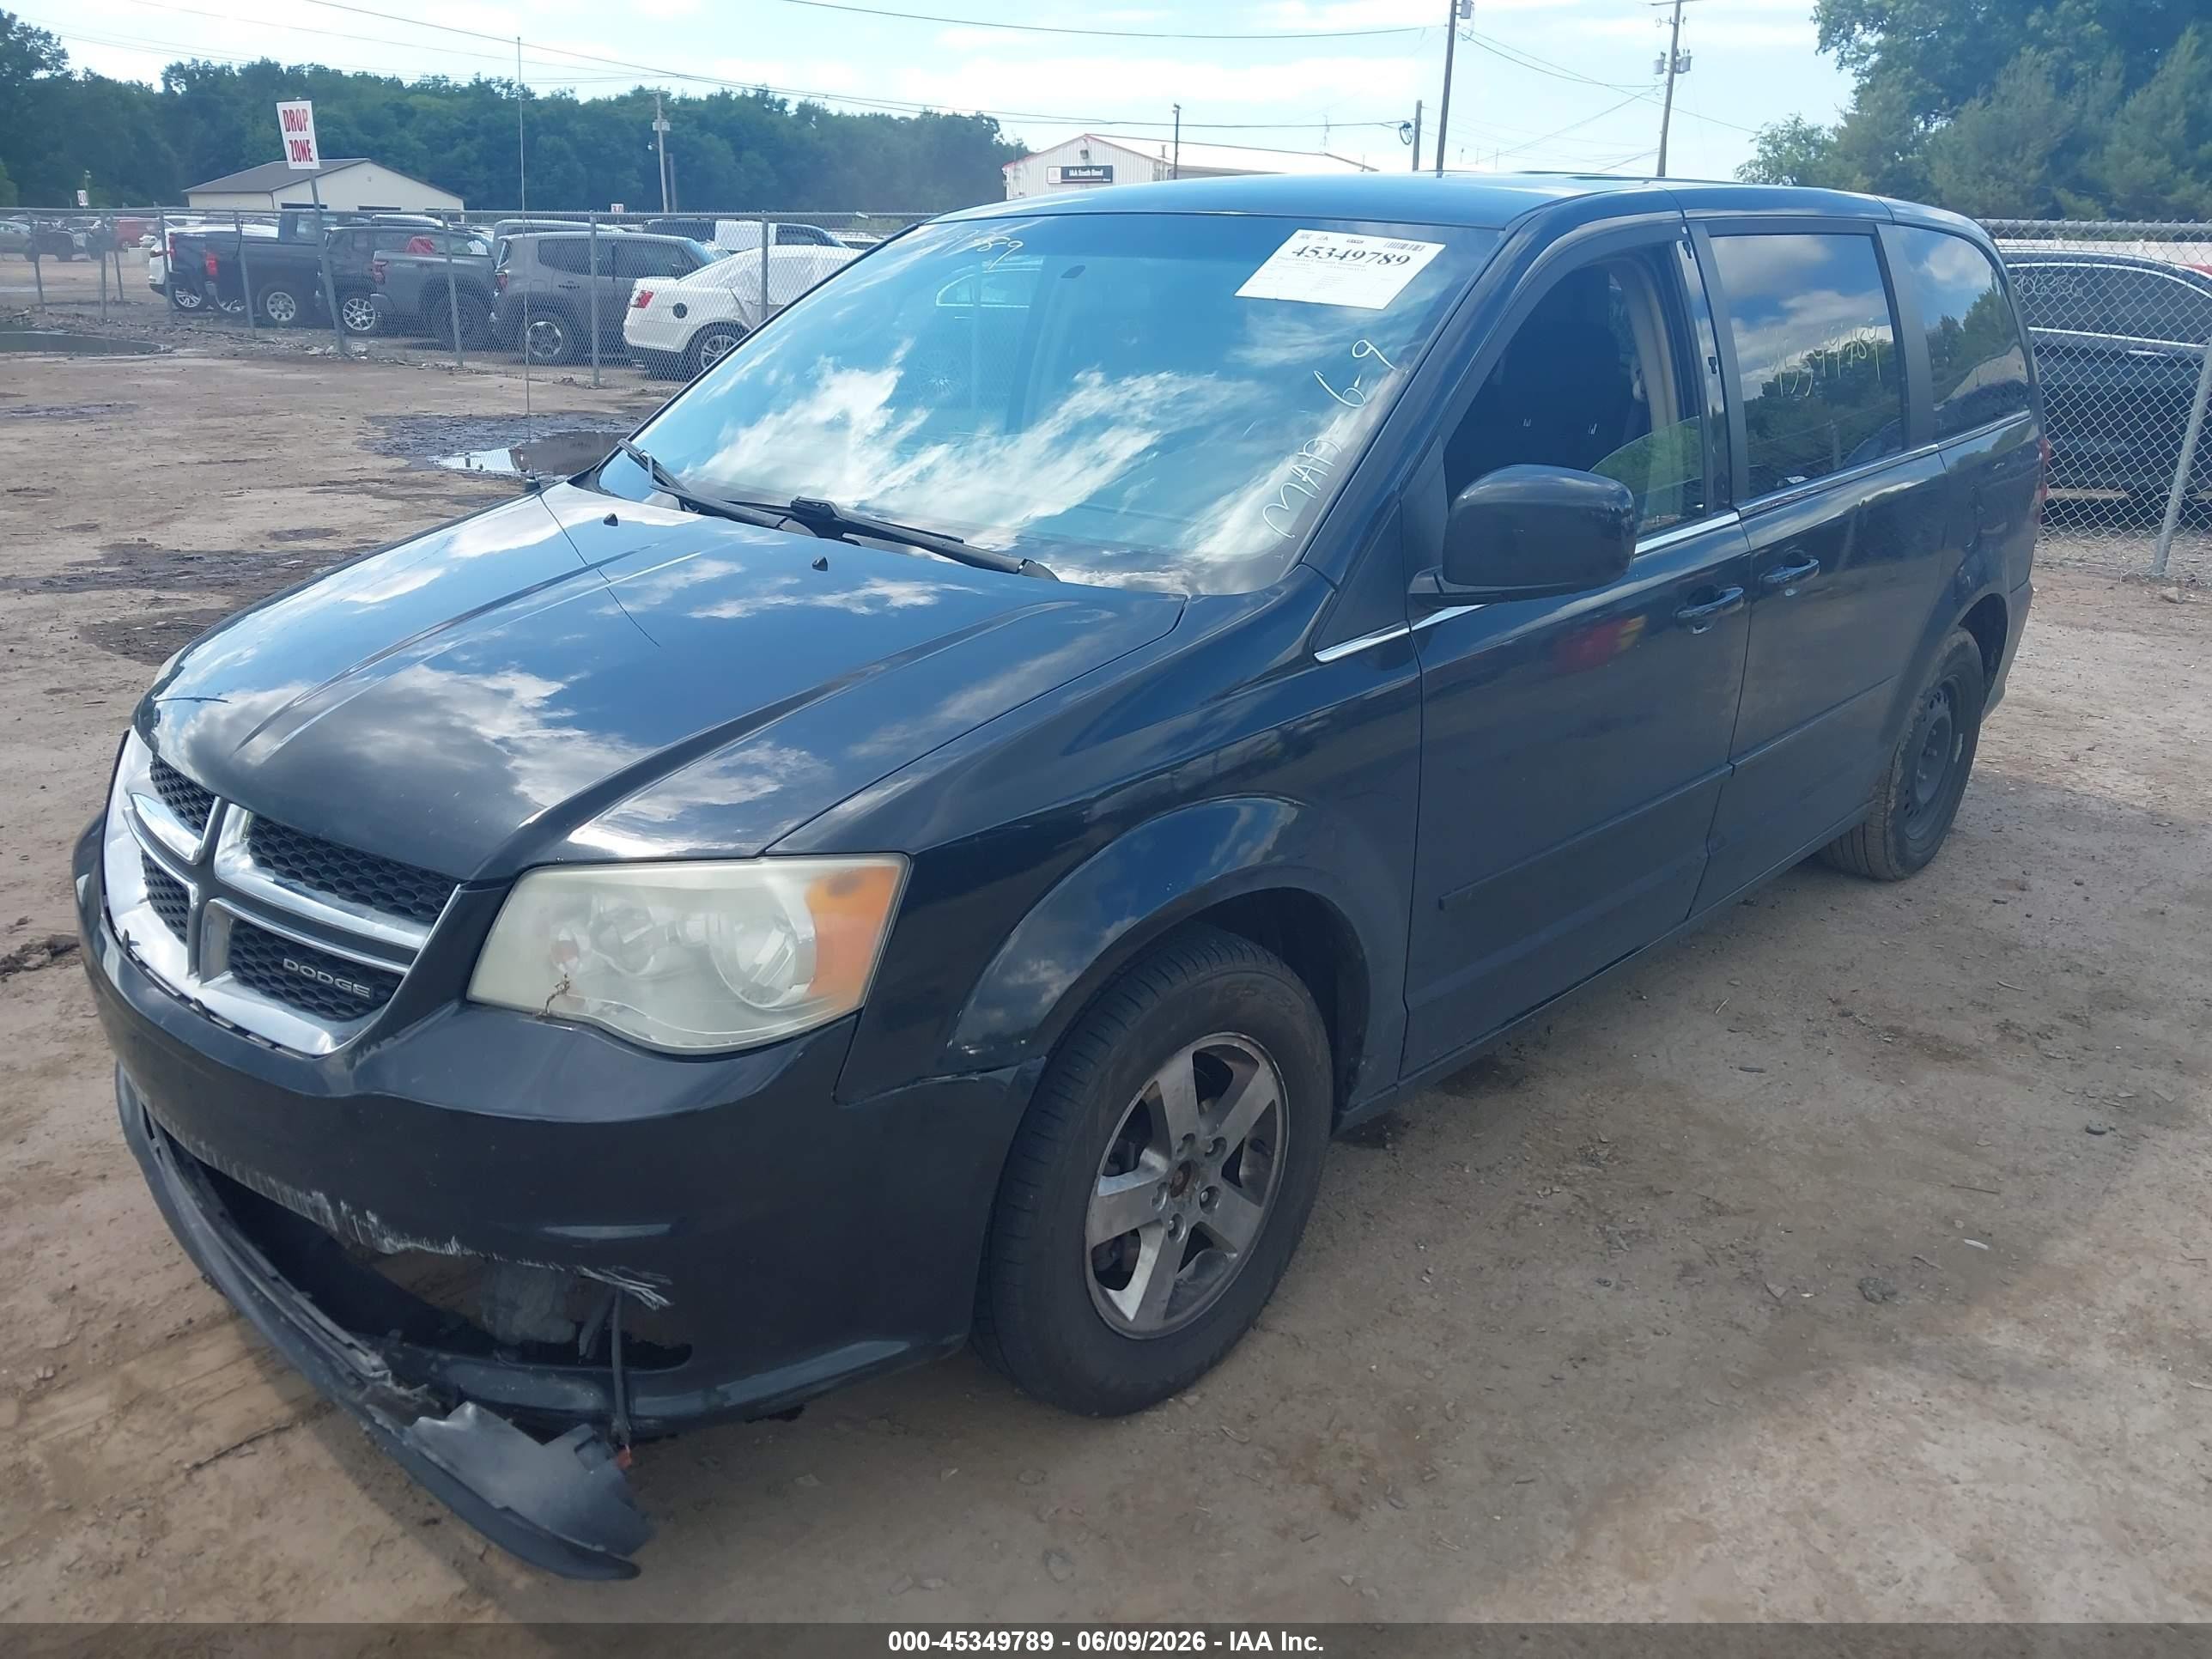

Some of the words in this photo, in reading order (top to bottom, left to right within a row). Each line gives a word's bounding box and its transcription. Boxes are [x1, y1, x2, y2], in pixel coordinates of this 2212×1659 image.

[282, 108, 308, 132] DROP
[289, 139, 313, 162] ZONE
[1291, 244, 1411, 267] 45349789
[283, 957, 371, 999] DODGE
